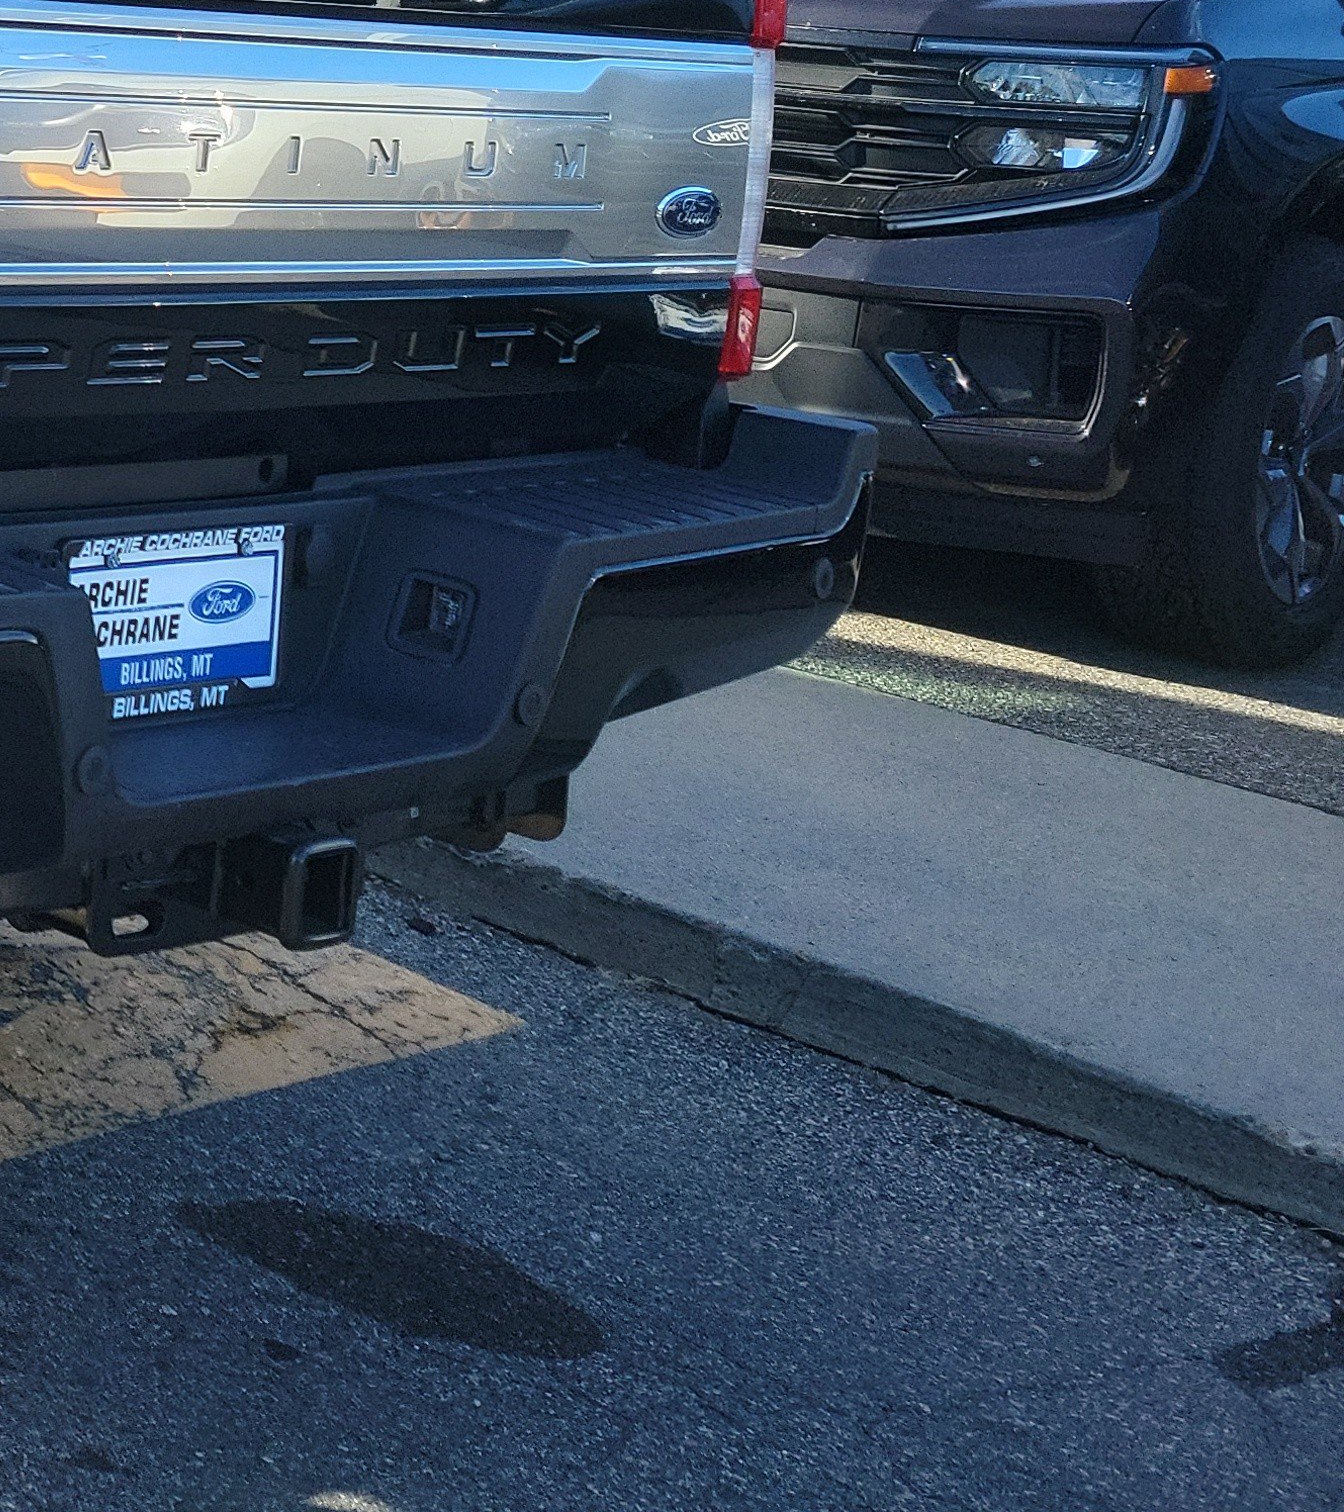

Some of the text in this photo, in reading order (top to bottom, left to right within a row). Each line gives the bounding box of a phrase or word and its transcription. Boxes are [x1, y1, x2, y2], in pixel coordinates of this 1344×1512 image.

[302, 324, 601, 376] DUTY
[79, 525, 285, 559] ARCHIE COCHRANE FORD
[79, 577, 150, 608] RCHIE
[202, 587, 242, 616] Ford
[97, 613, 181, 648] CHRANE
[120, 653, 214, 686] BILLINGS, MT
[113, 685, 229, 719] BILLINGS, MT
